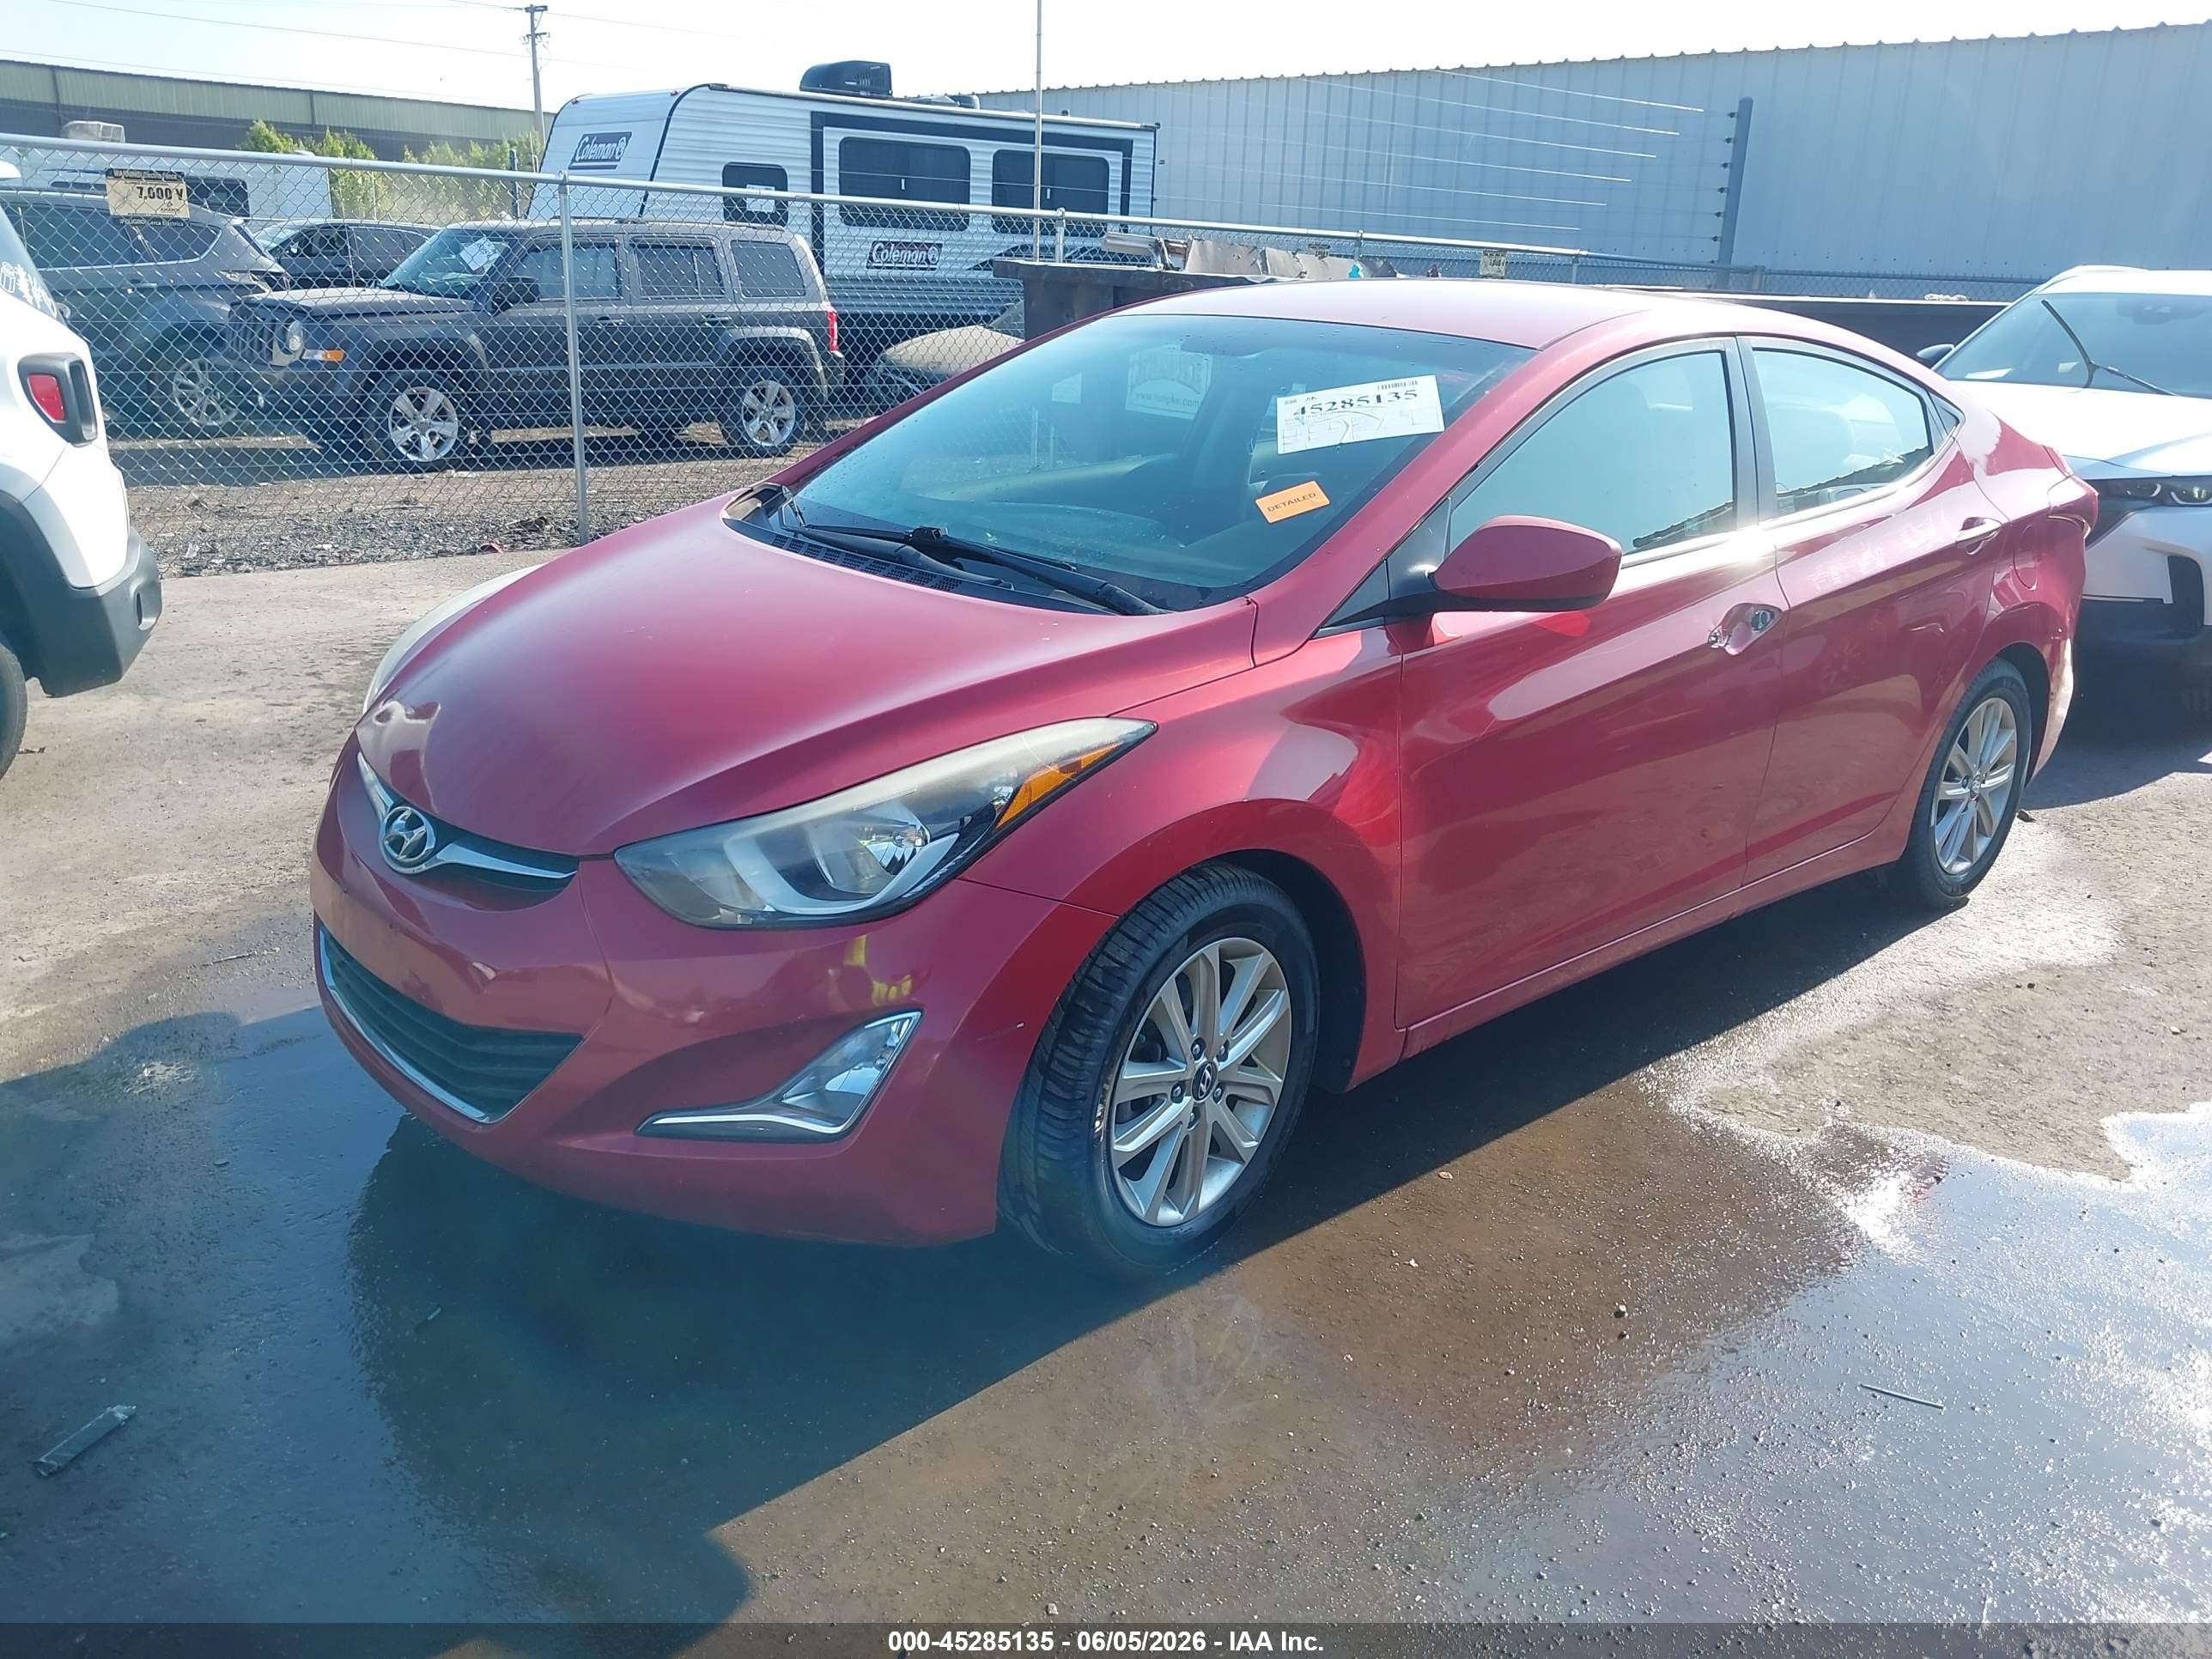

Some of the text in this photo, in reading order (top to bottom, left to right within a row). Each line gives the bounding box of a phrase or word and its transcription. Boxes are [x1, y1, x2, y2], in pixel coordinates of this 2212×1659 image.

[574, 136, 617, 161] Coleman
[175, 188, 184, 201] V
[872, 242, 927, 263] Coleman
[1293, 389, 1418, 416] 45285135
[1267, 492, 1316, 512] DETAILED
